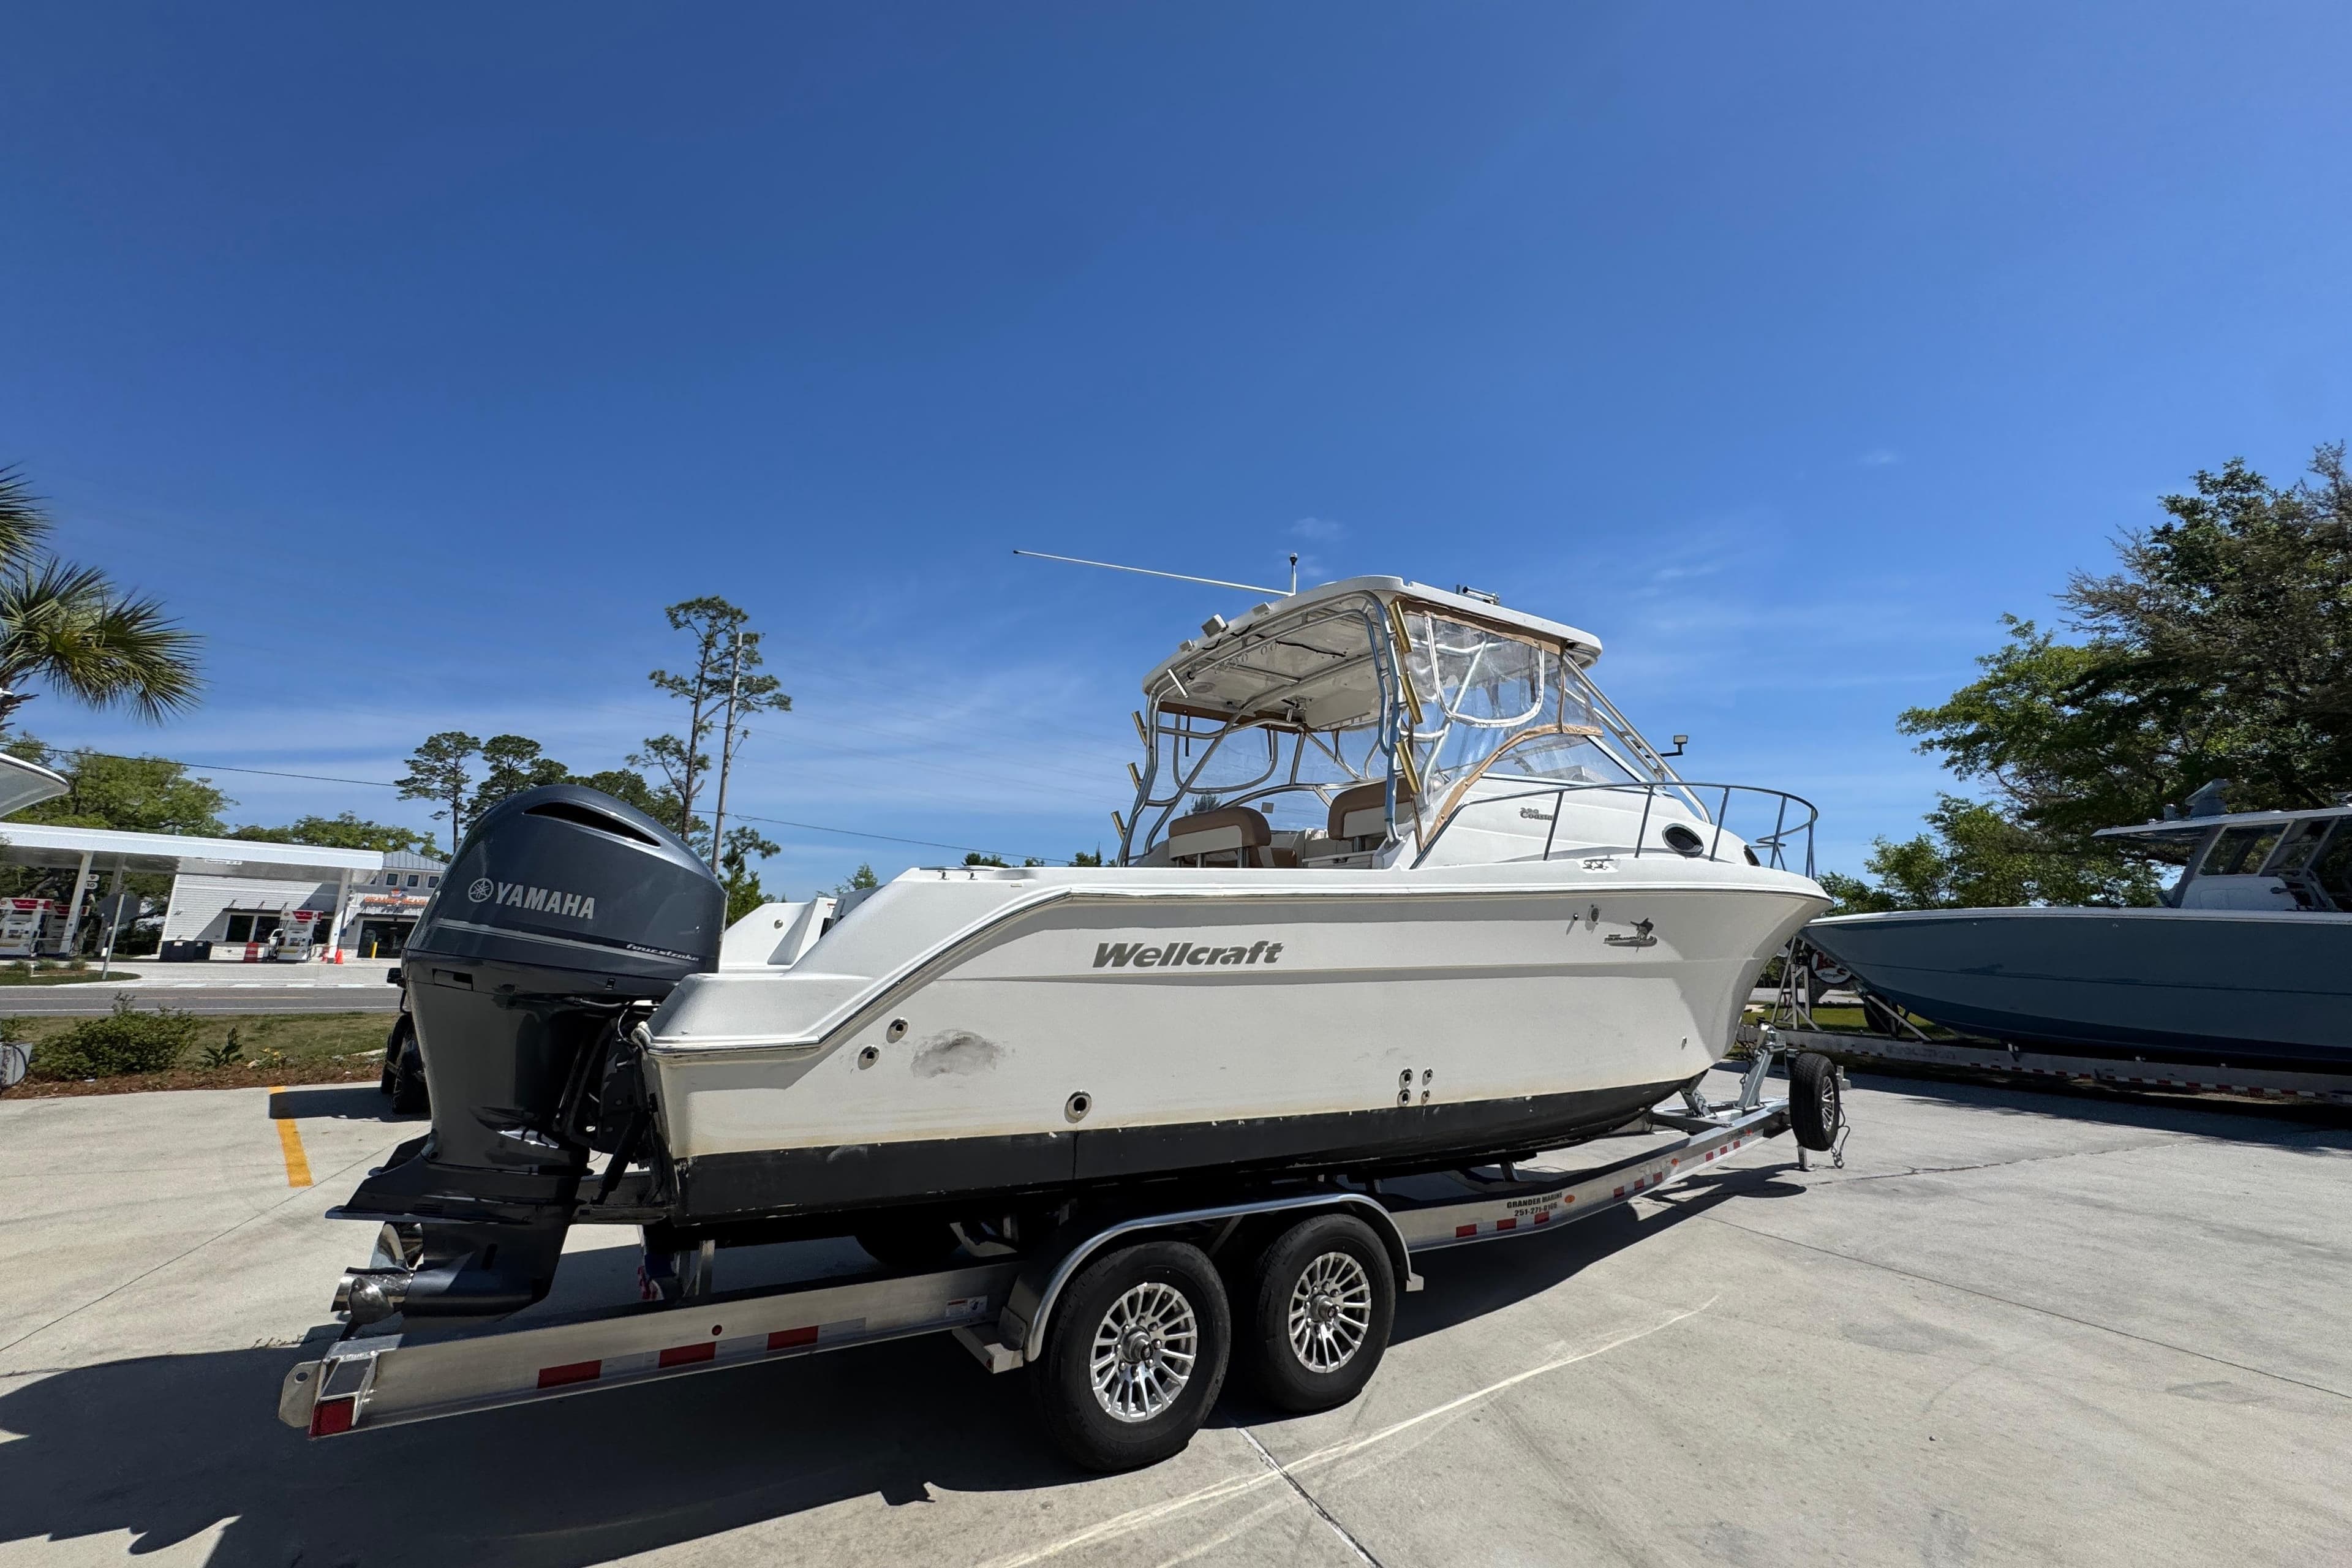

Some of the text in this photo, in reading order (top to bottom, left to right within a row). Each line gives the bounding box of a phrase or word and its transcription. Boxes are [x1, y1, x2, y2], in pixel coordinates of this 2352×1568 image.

[1520, 812, 1554, 821] Coasta
[496, 881, 595, 919] YAMAHA
[1092, 940, 1285, 968] Wellcraft
[1507, 1191, 1562, 1208] GRANDER MARINE
